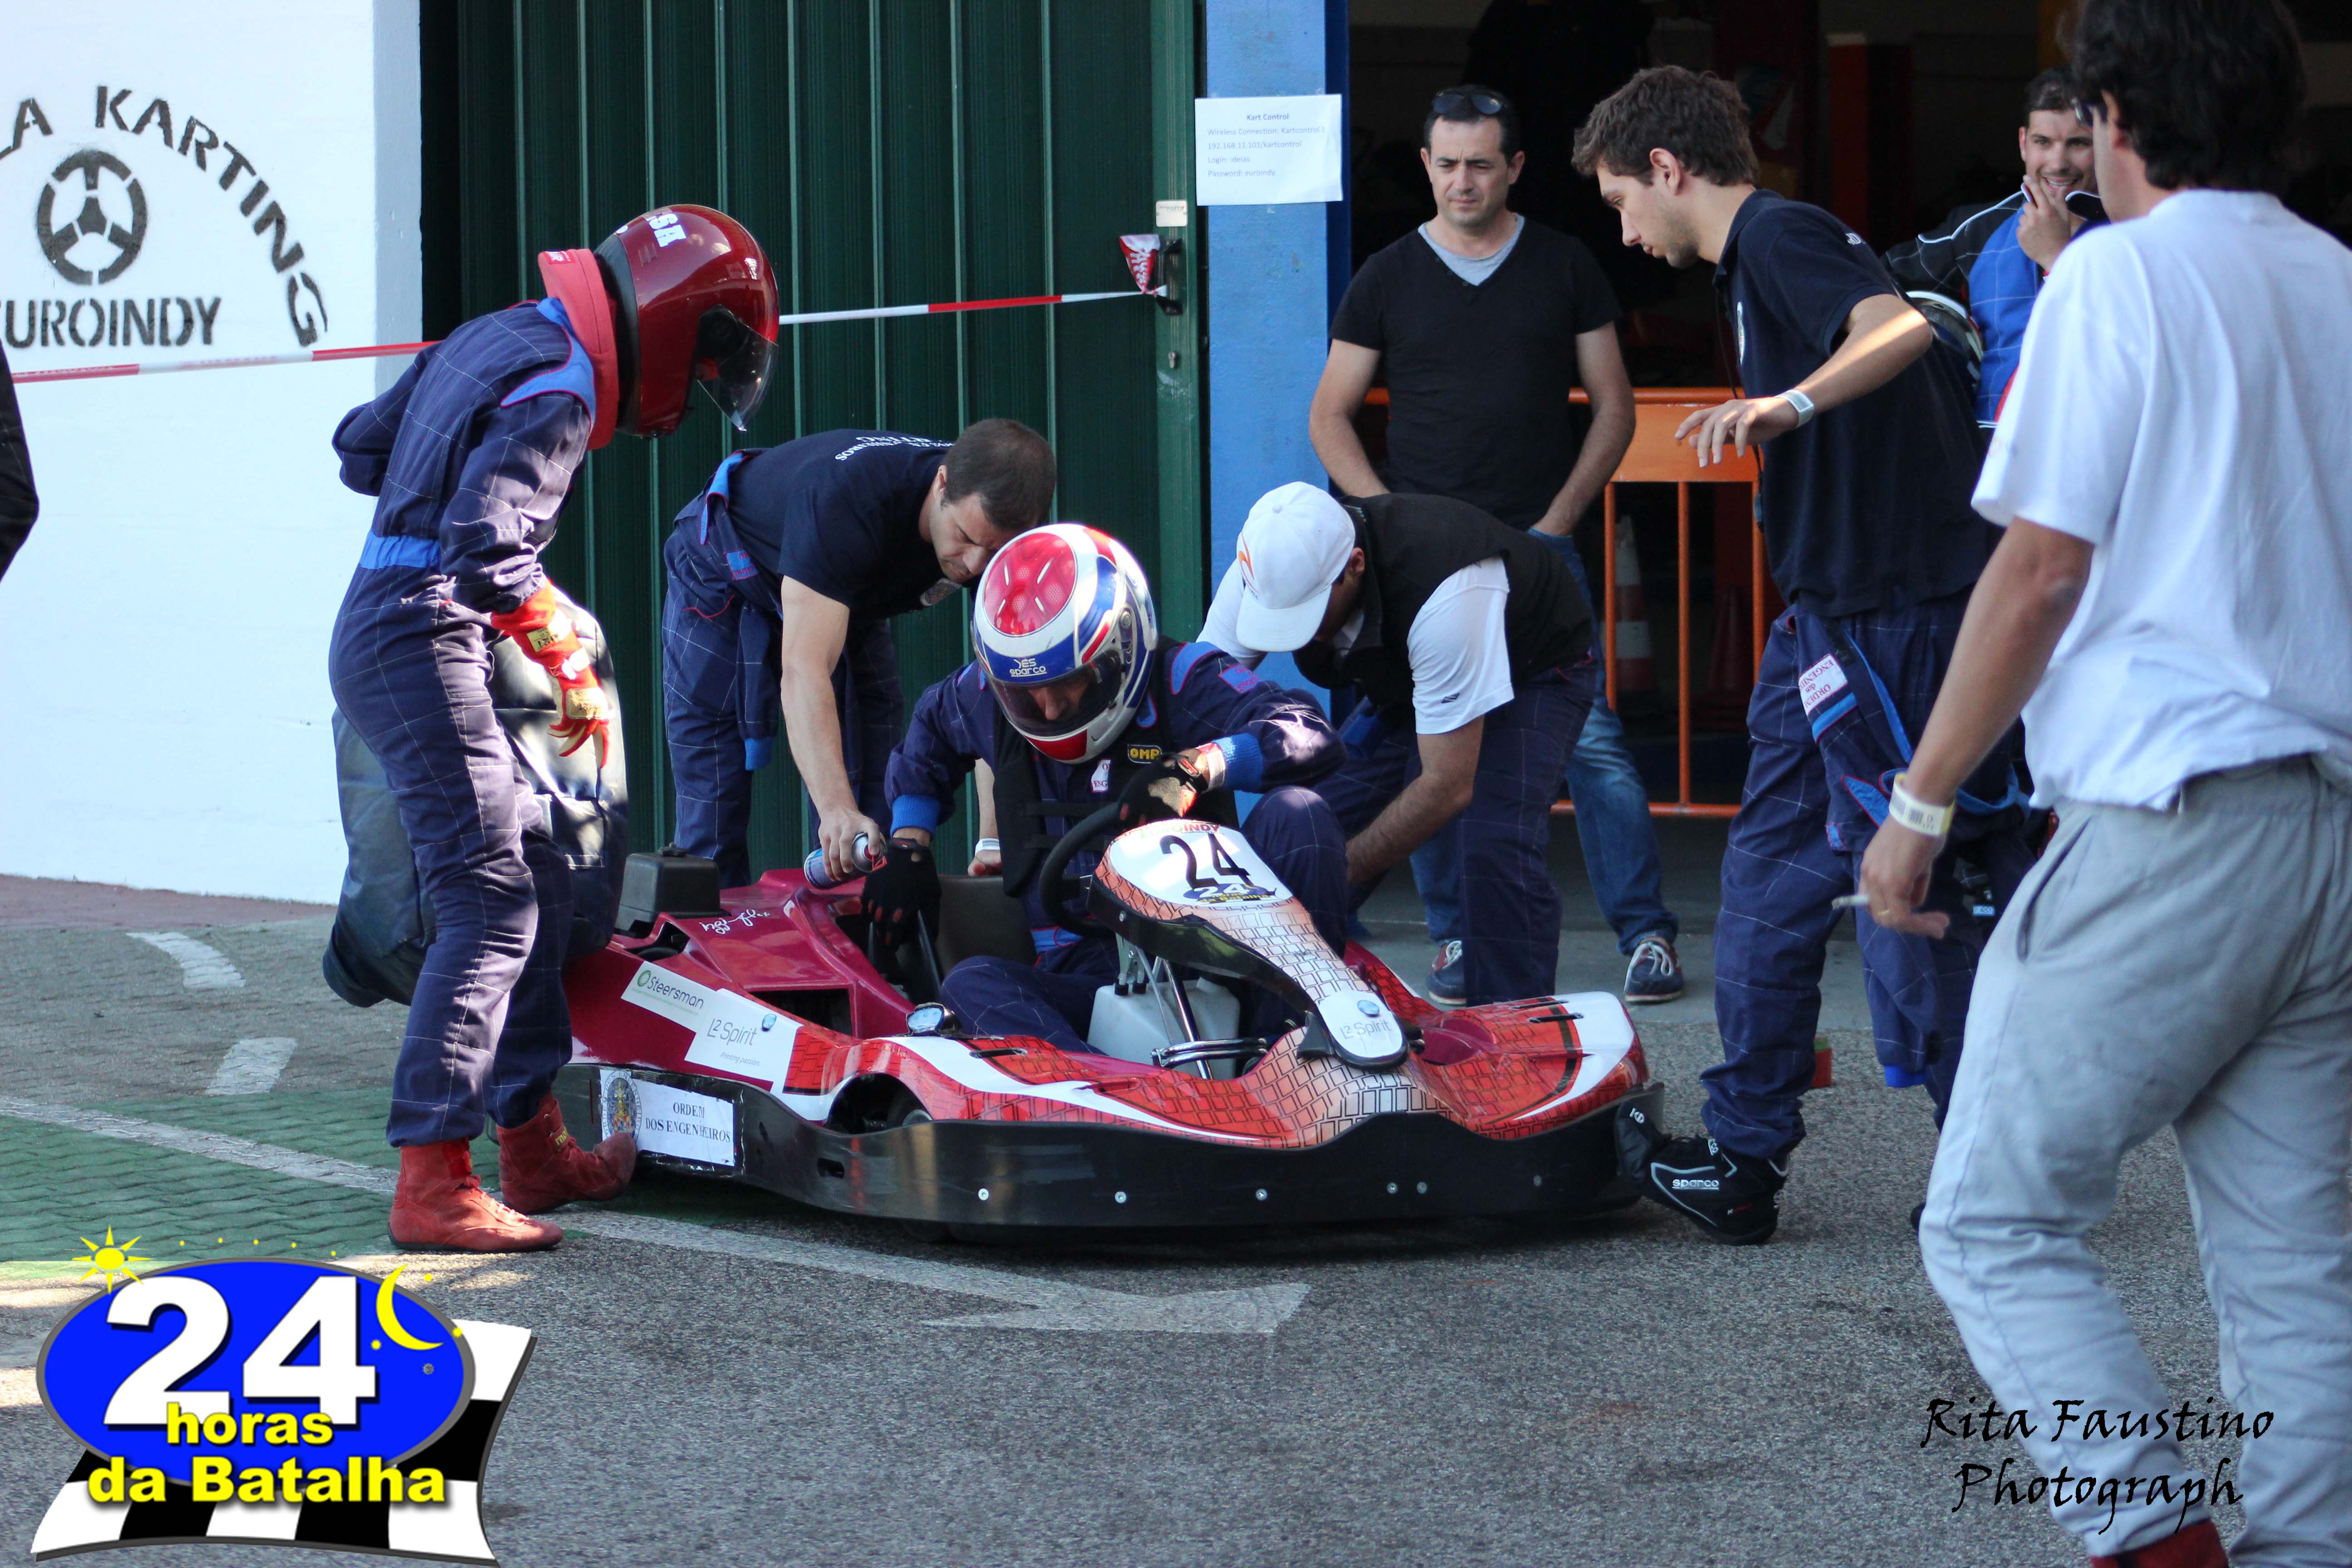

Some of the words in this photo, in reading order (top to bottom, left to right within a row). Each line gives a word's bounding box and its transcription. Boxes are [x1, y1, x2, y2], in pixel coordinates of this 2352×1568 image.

[95, 85, 328, 348] KARTING
[0, 297, 221, 348] UROINDY
[1012, 657, 1037, 669] YES
[1009, 666, 1047, 677] sparco
[1129, 748, 1159, 760] OMP
[1159, 832, 1255, 890] 24
[1199, 883, 1250, 898] 24
[647, 976, 704, 1009] Steersman
[720, 1022, 758, 1046] Spirit
[1353, 1019, 1392, 1036] Spirit
[720, 1051, 741, 1064] Printing
[672, 1102, 705, 1118] ORDEM
[646, 1117, 664, 1131] DOS
[666, 1120, 731, 1143] ENGENHEIROS
[1672, 1179, 1720, 1190] sparco
